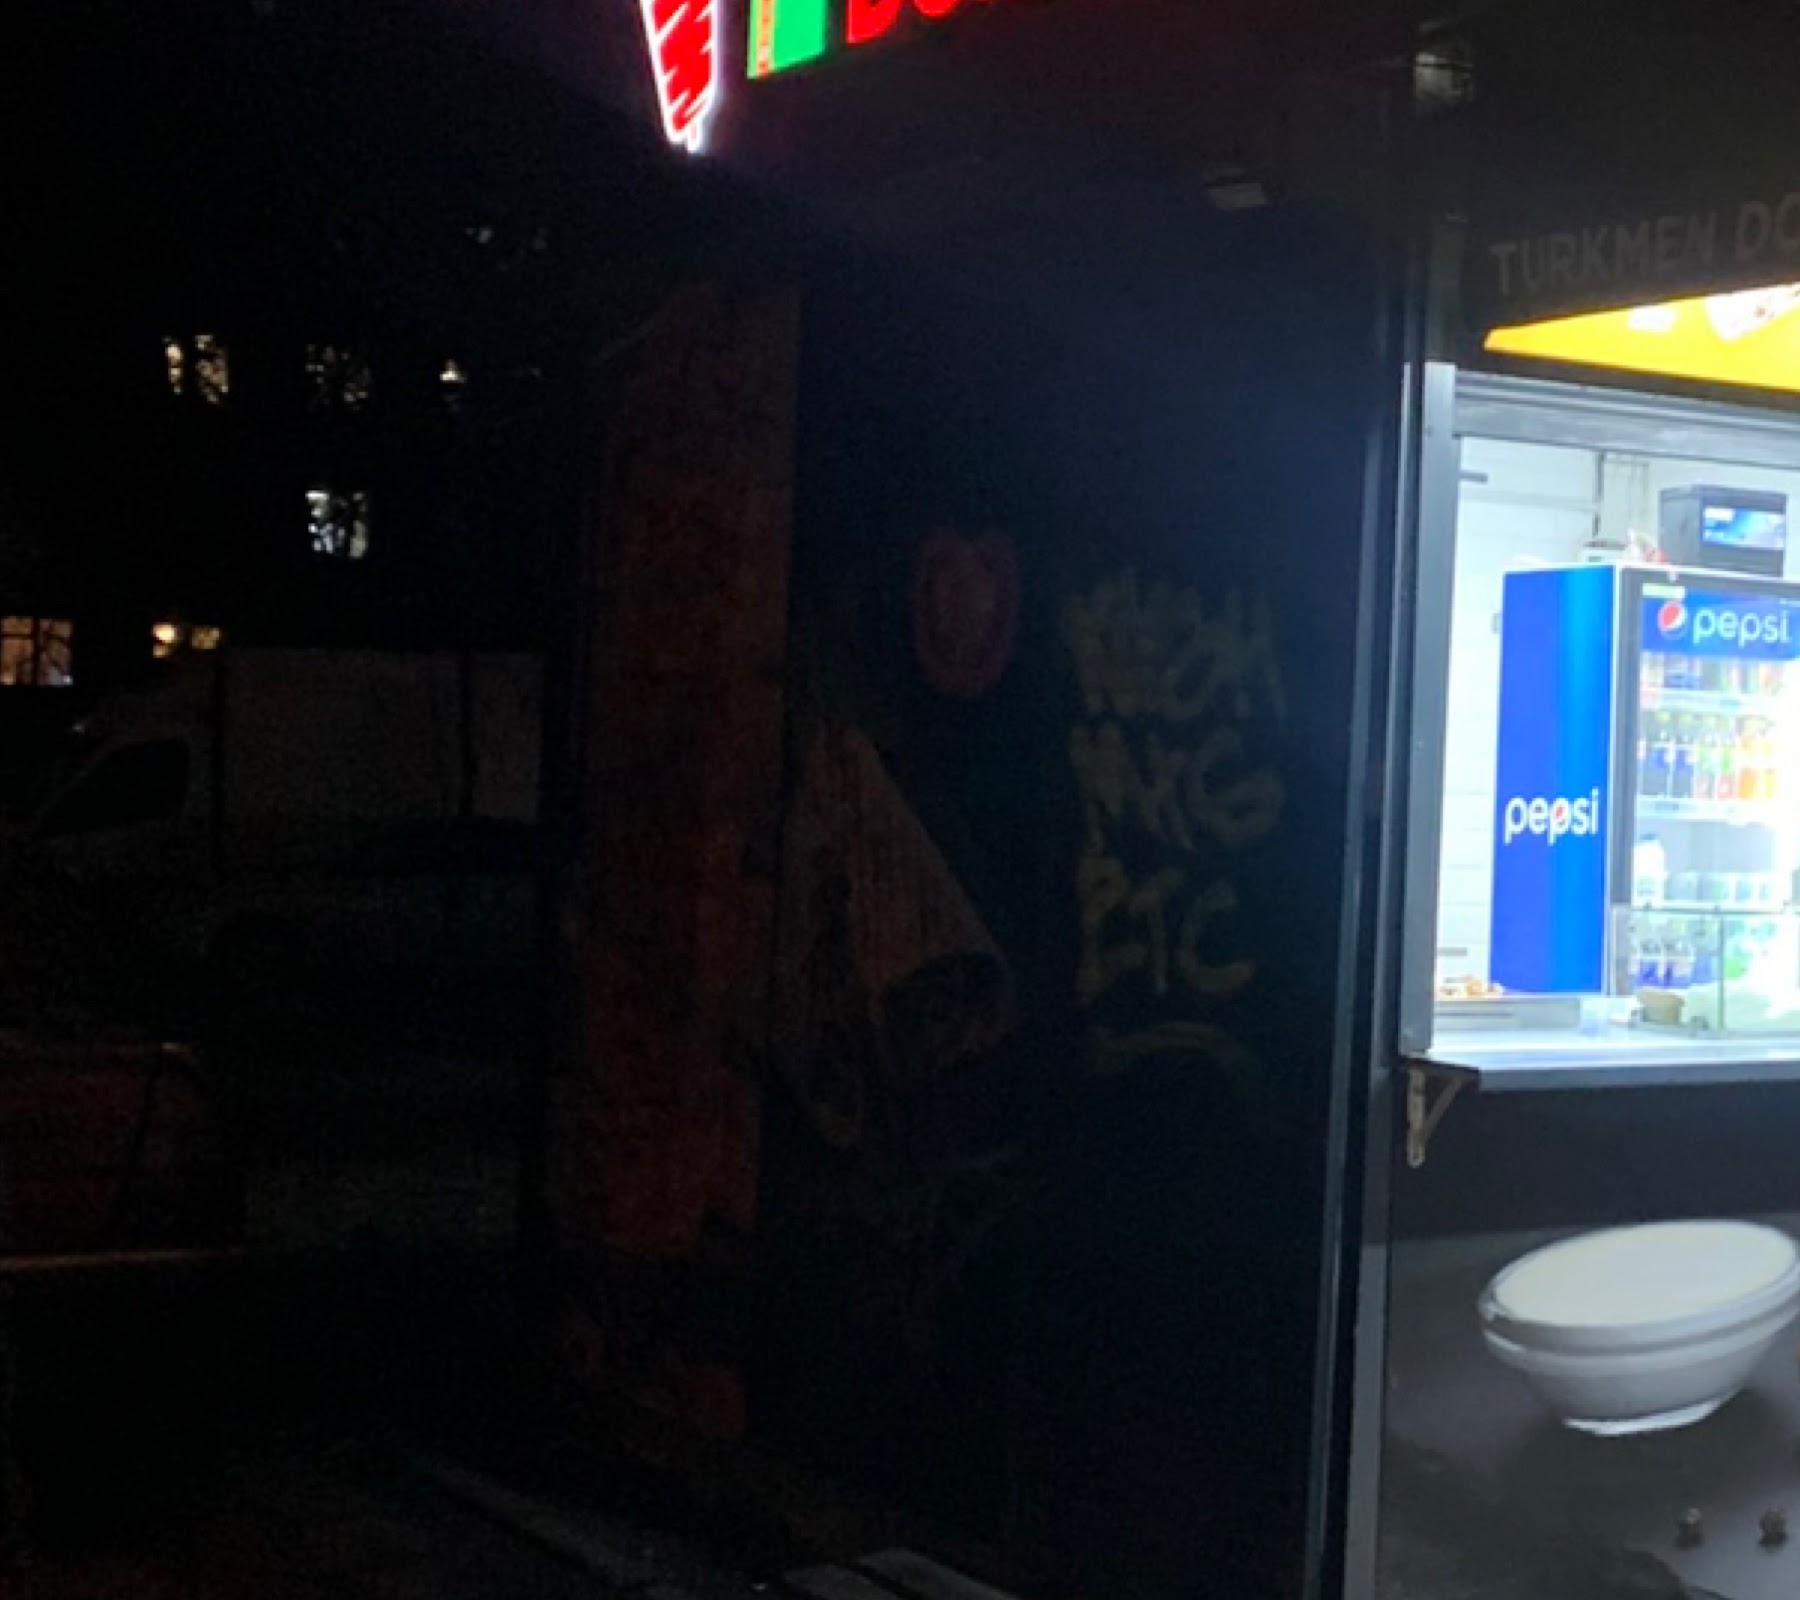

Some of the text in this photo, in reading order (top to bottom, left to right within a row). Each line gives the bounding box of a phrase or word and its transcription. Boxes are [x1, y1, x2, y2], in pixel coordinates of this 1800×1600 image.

[1490, 212, 1718, 296] TURKMEN
[1693, 602, 1792, 649] pepsi
[1504, 787, 1600, 845] pepsi
